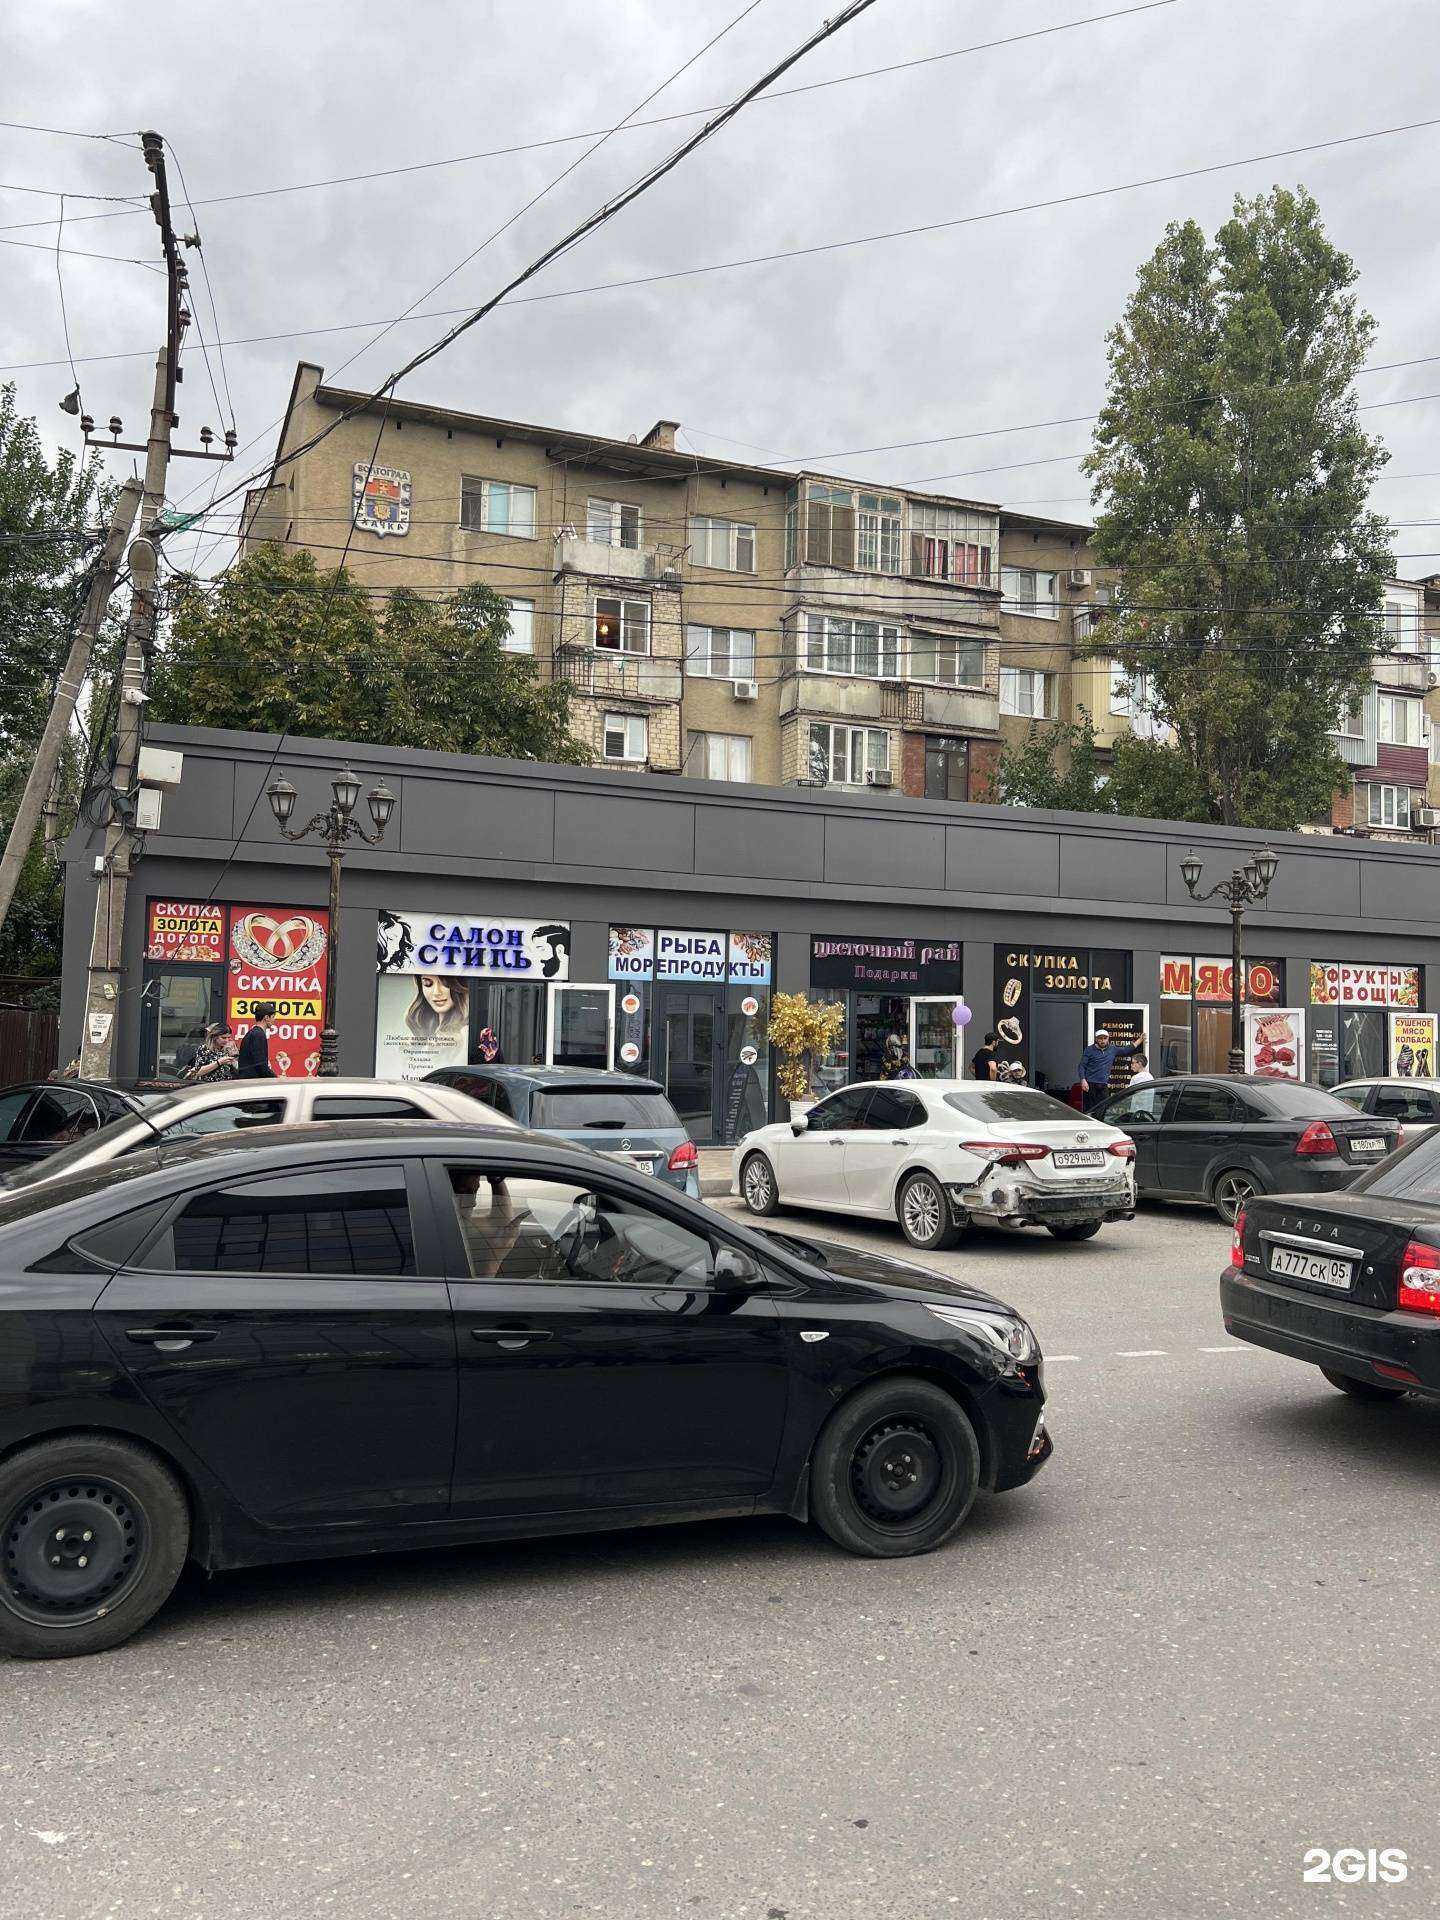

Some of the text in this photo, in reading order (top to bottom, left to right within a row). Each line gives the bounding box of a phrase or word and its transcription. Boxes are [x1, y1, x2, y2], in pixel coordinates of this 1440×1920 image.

[155, 903, 222, 918] СКУПКА
[157, 918, 219, 932] ЗОЛОТА
[154, 933, 219, 945] ДОРОГО
[429, 924, 524, 946] САЛОН
[661, 937, 721, 955] РЫБА
[418, 944, 532, 969] СТИЛЬ
[1007, 953, 1079, 970] СКУПКА
[615, 957, 765, 978] МОРЕПРОДУКТЫ
[854, 965, 918, 982] Подарки
[238, 975, 322, 992] СКУПКА
[1045, 974, 1112, 990] ЗОЛОТА
[1327, 968, 1401, 985] ФРУКТЫ
[1328, 986, 1399, 1004] ОВОЩИ
[236, 1000, 316, 1016] ЗООТА
[234, 1024, 316, 1040] ДРОГО
[1395, 1036, 1432, 1044] КОЛБАСА
[1281, 1217, 1338, 1238] LADA
[1331, 1262, 1346, 1279] 05
